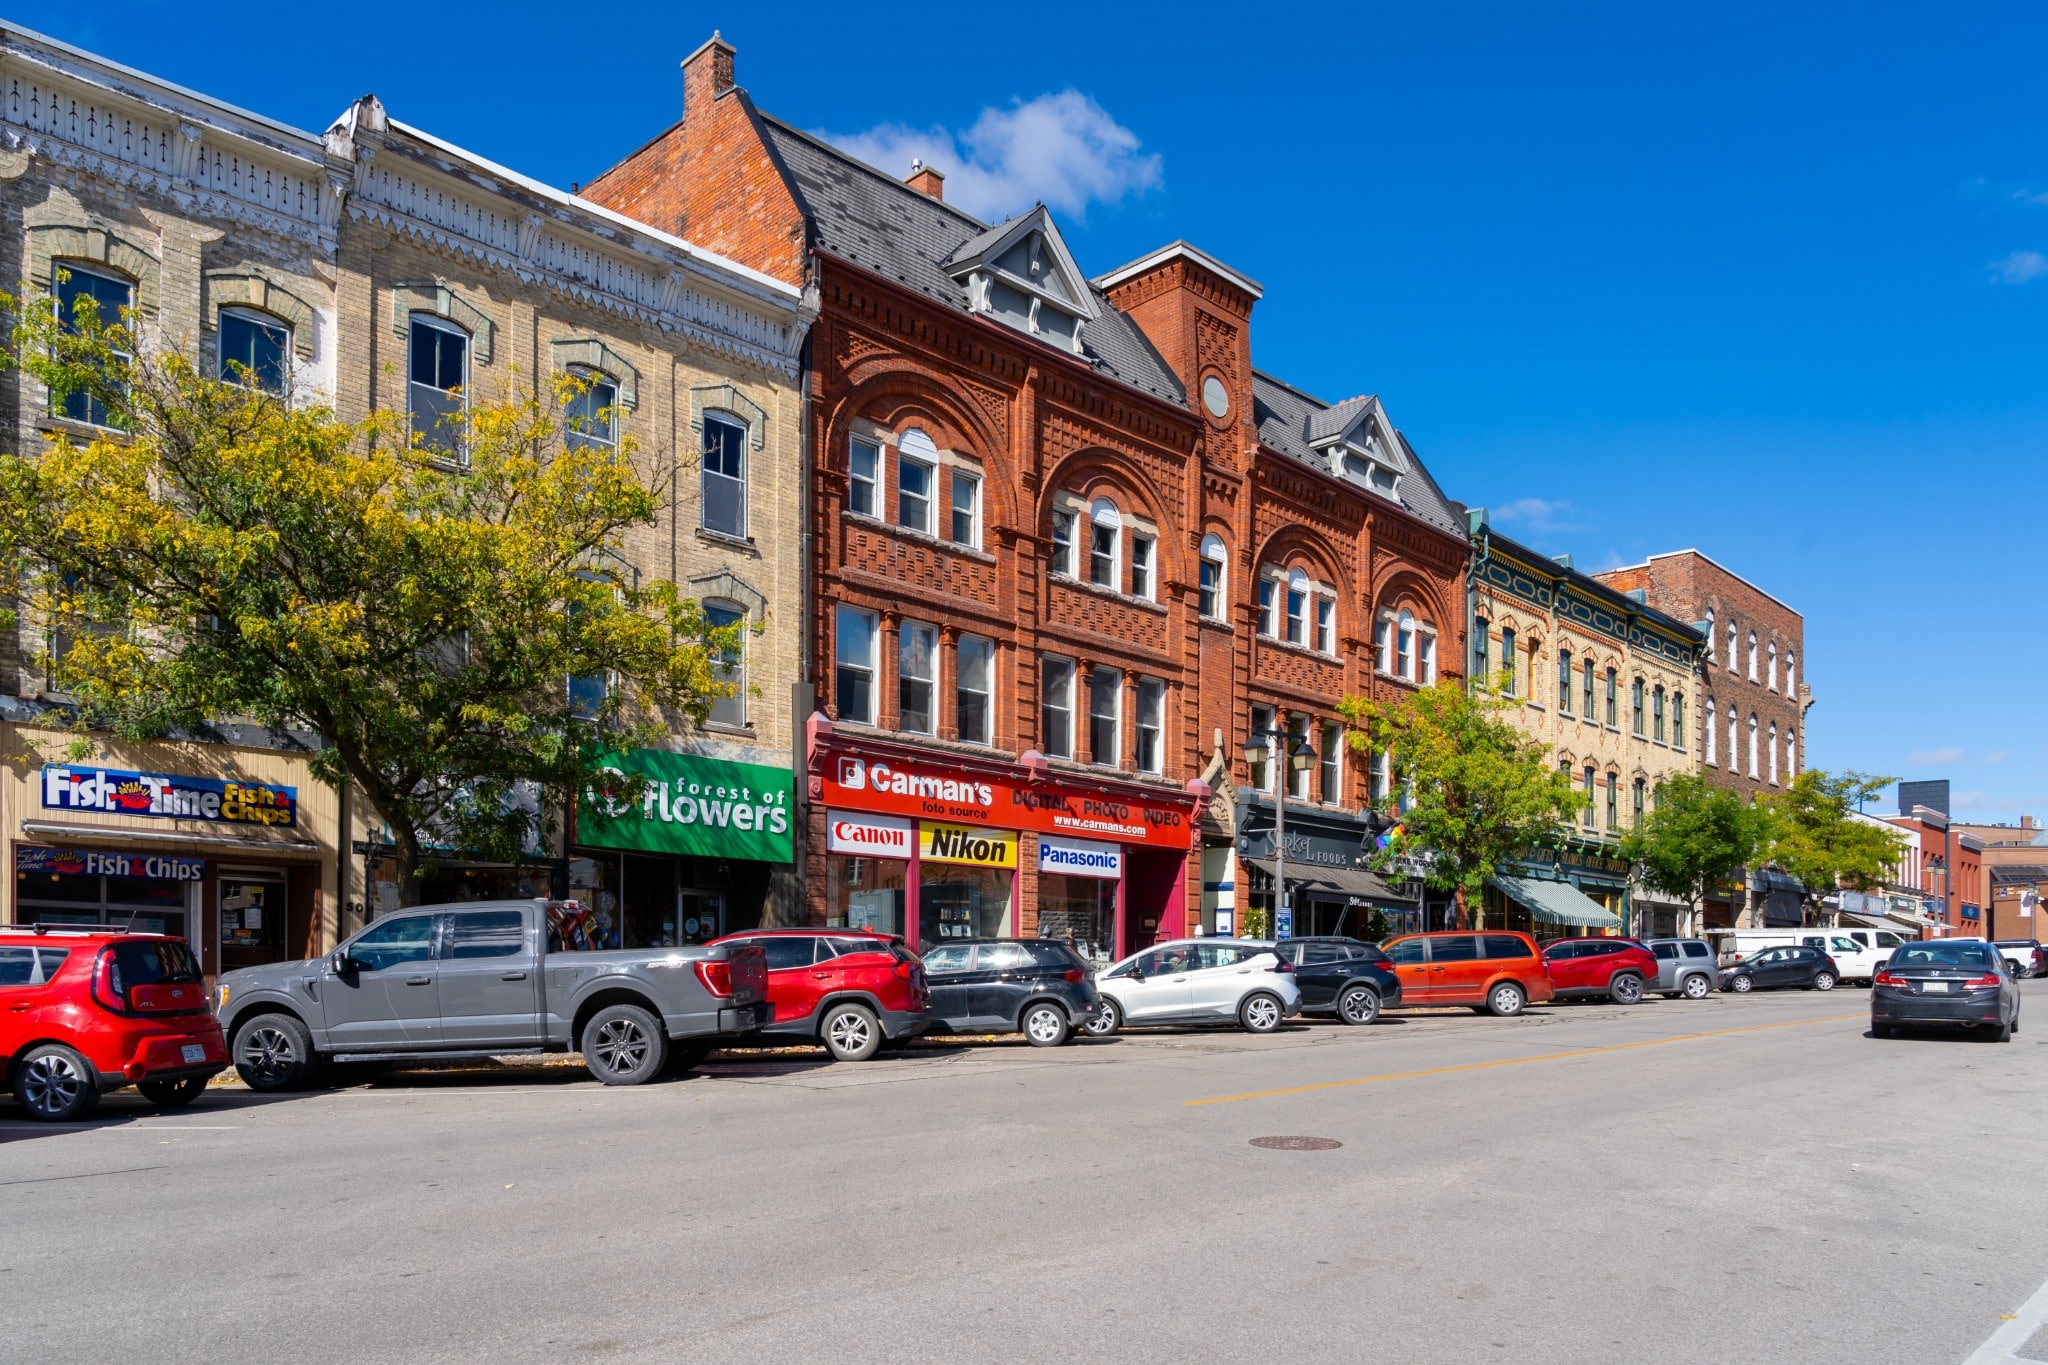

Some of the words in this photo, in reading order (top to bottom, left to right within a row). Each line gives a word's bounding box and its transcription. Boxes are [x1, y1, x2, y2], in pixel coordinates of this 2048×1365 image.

[46, 767, 117, 810] Fish
[139, 775, 220, 819] Time
[224, 783, 275, 805] Fish
[677, 777, 750, 801] forest
[763, 790, 785, 805] of
[870, 762, 992, 806] Carman's
[220, 801, 291, 826] Chips
[643, 780, 787, 834] flowers
[922, 801, 945, 814] foto
[949, 805, 988, 819] source
[1012, 789, 1070, 812] DIGITAL
[1083, 800, 1129, 820] PHOTO
[1143, 808, 1181, 827] VIDEO
[835, 821, 904, 847] Canon
[1053, 815, 1146, 837] www.carmans.com
[931, 828, 1006, 862] Nikon
[1040, 844, 1117, 869] Panasonic
[1317, 851, 1347, 865] FOODS
